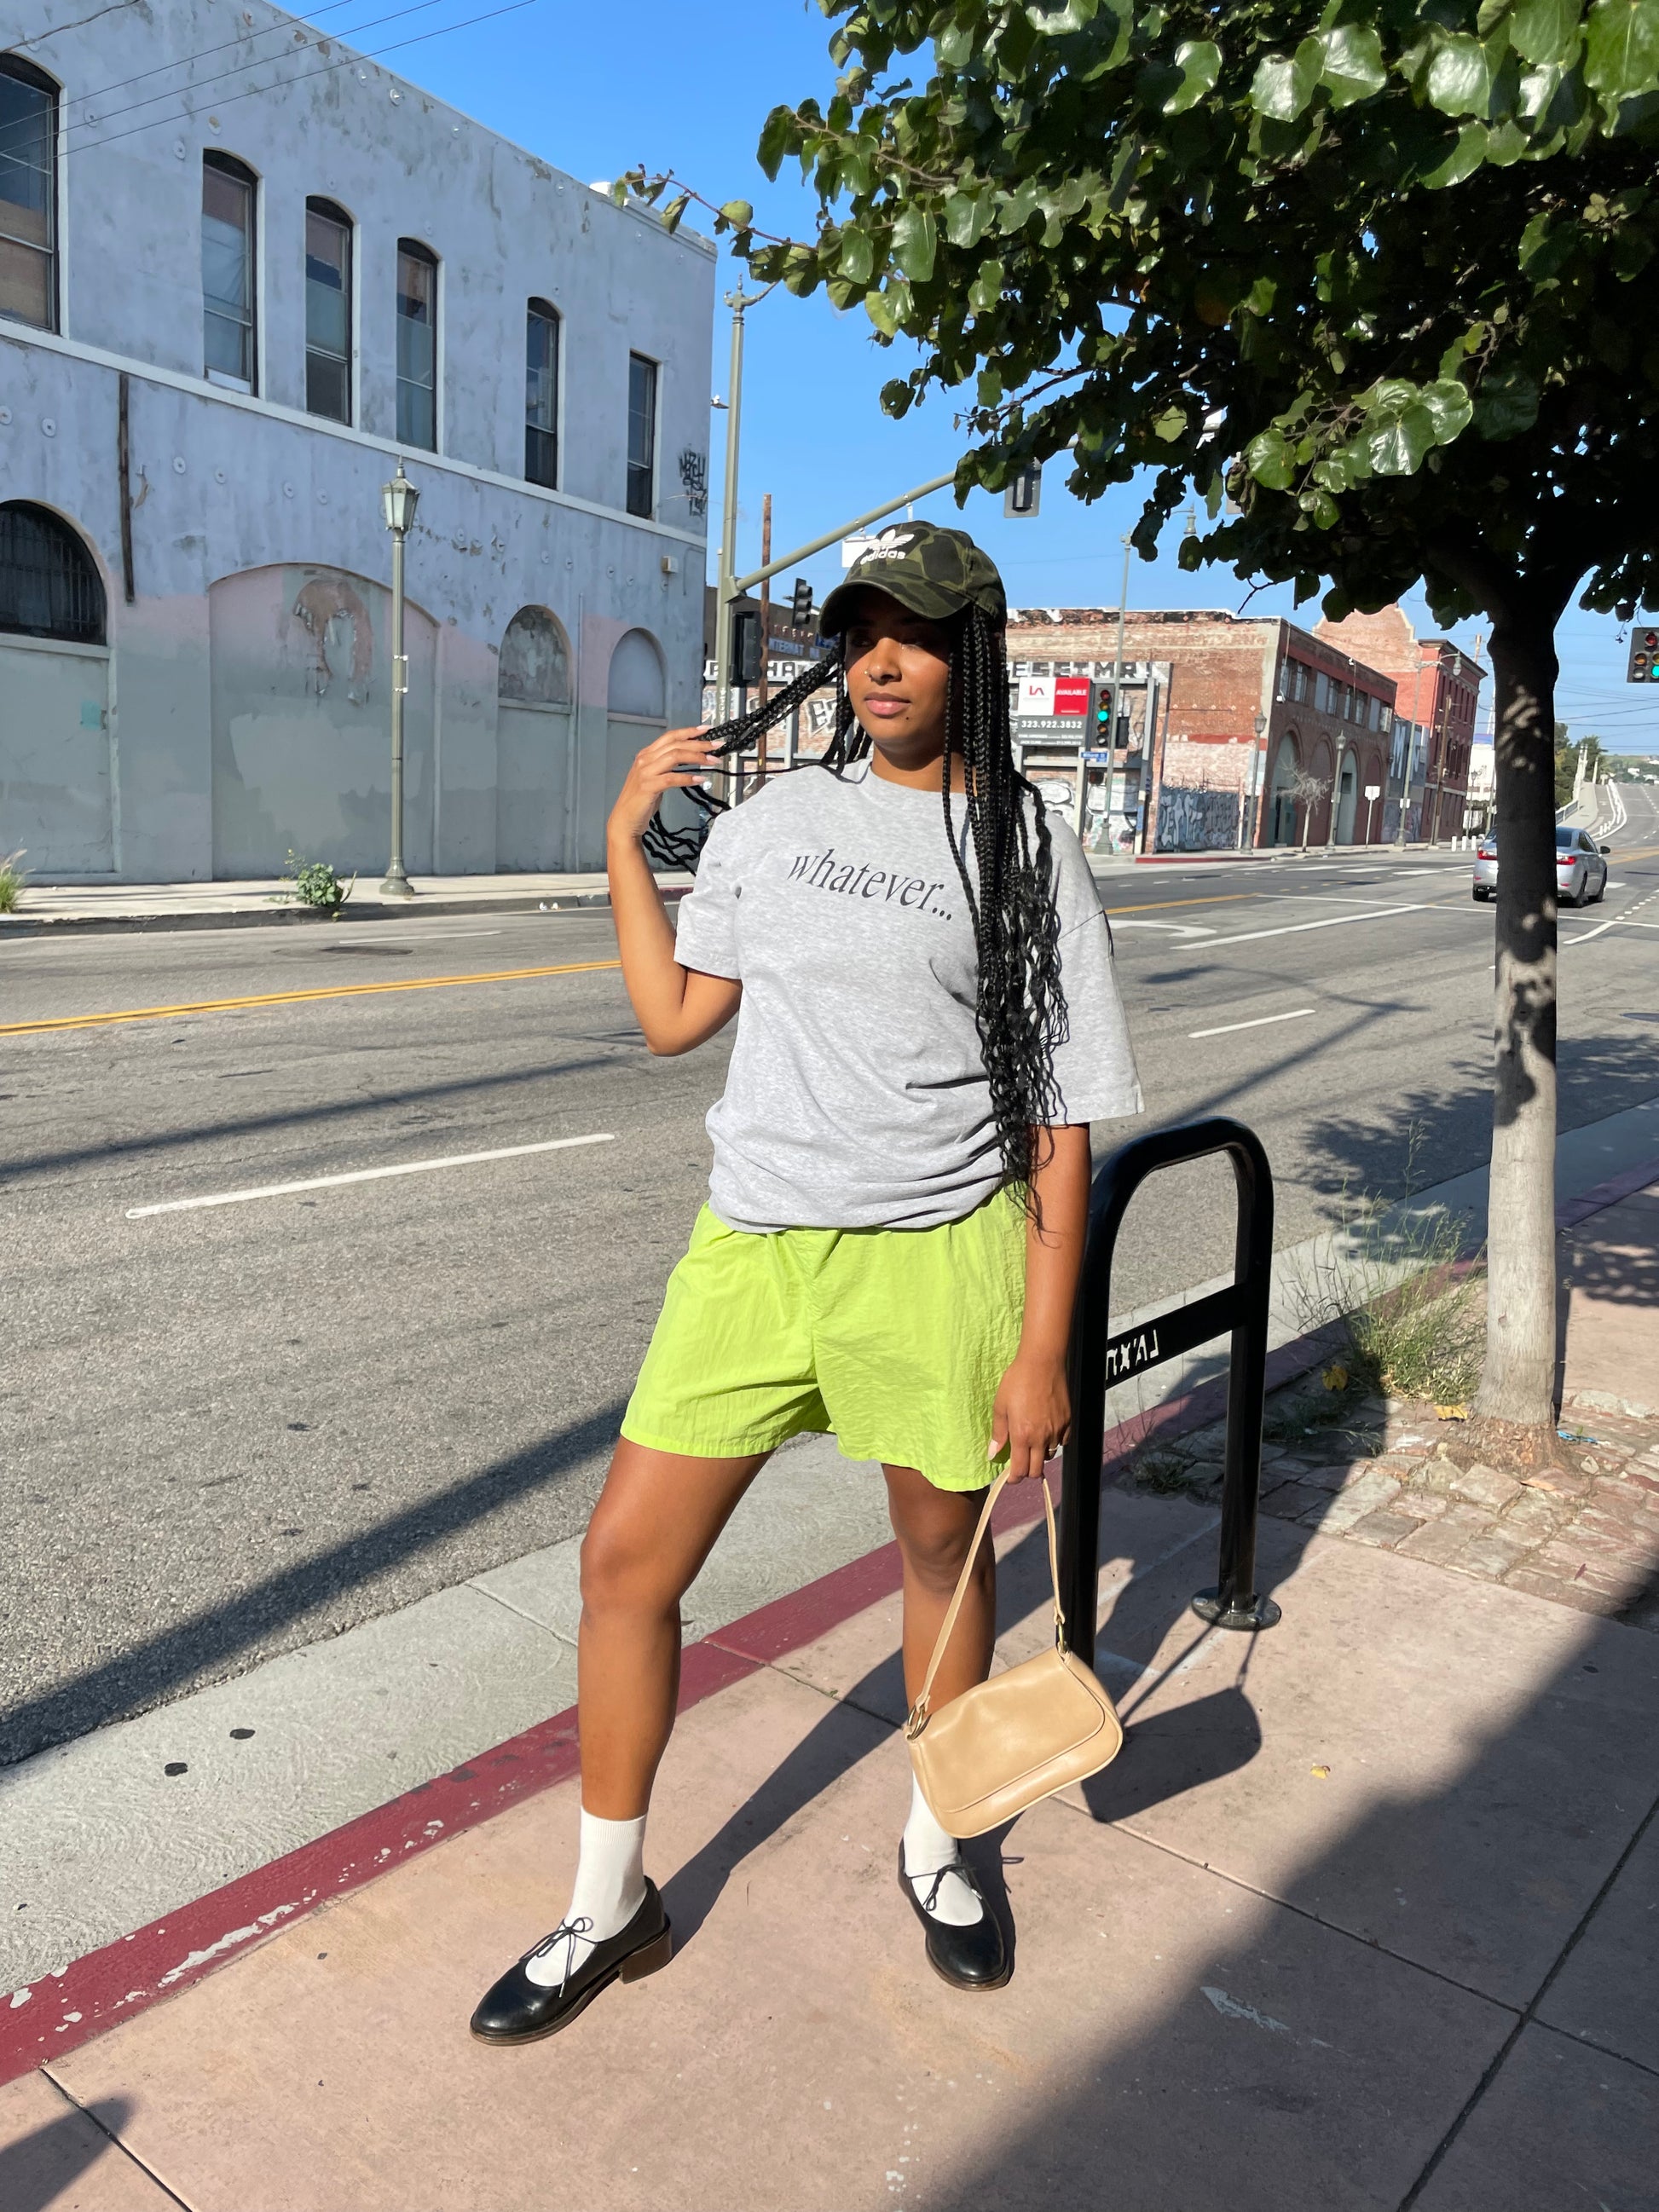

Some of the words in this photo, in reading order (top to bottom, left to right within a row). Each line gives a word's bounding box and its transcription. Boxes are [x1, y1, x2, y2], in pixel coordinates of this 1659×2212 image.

[859, 549, 906, 565] adidas
[1020, 720, 1083, 730] 323.922.3832
[787, 848, 952, 921] whatever...
